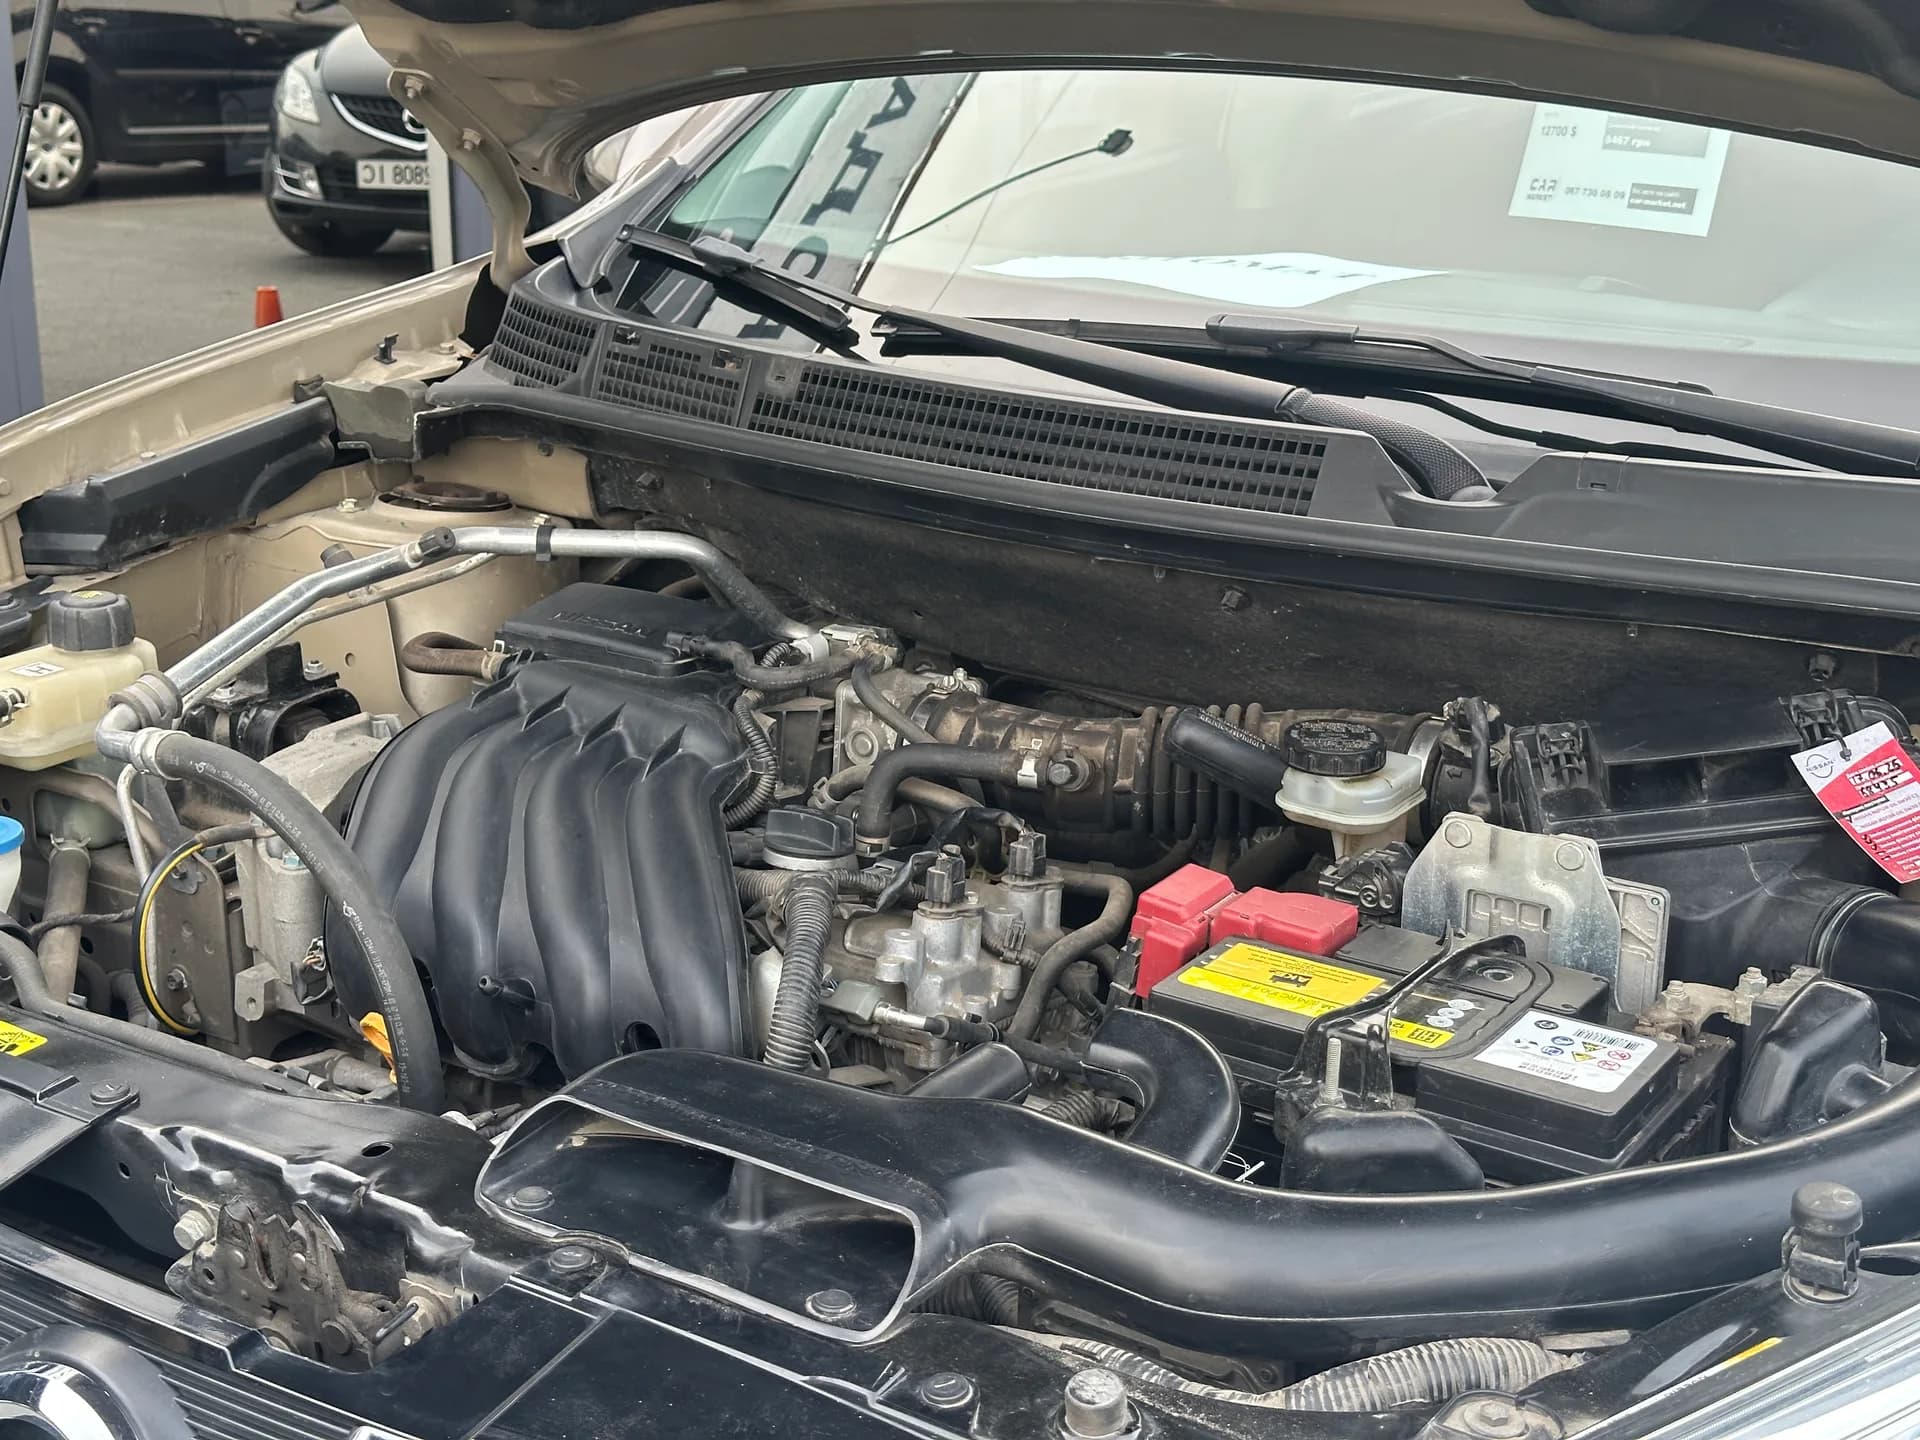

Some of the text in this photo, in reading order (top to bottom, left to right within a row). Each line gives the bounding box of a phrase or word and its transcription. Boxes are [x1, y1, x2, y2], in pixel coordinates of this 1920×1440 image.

[1541, 124, 1568, 137] 12700
[1529, 178, 1558, 192] CAR
[1806, 759, 1836, 772] NISSAN
